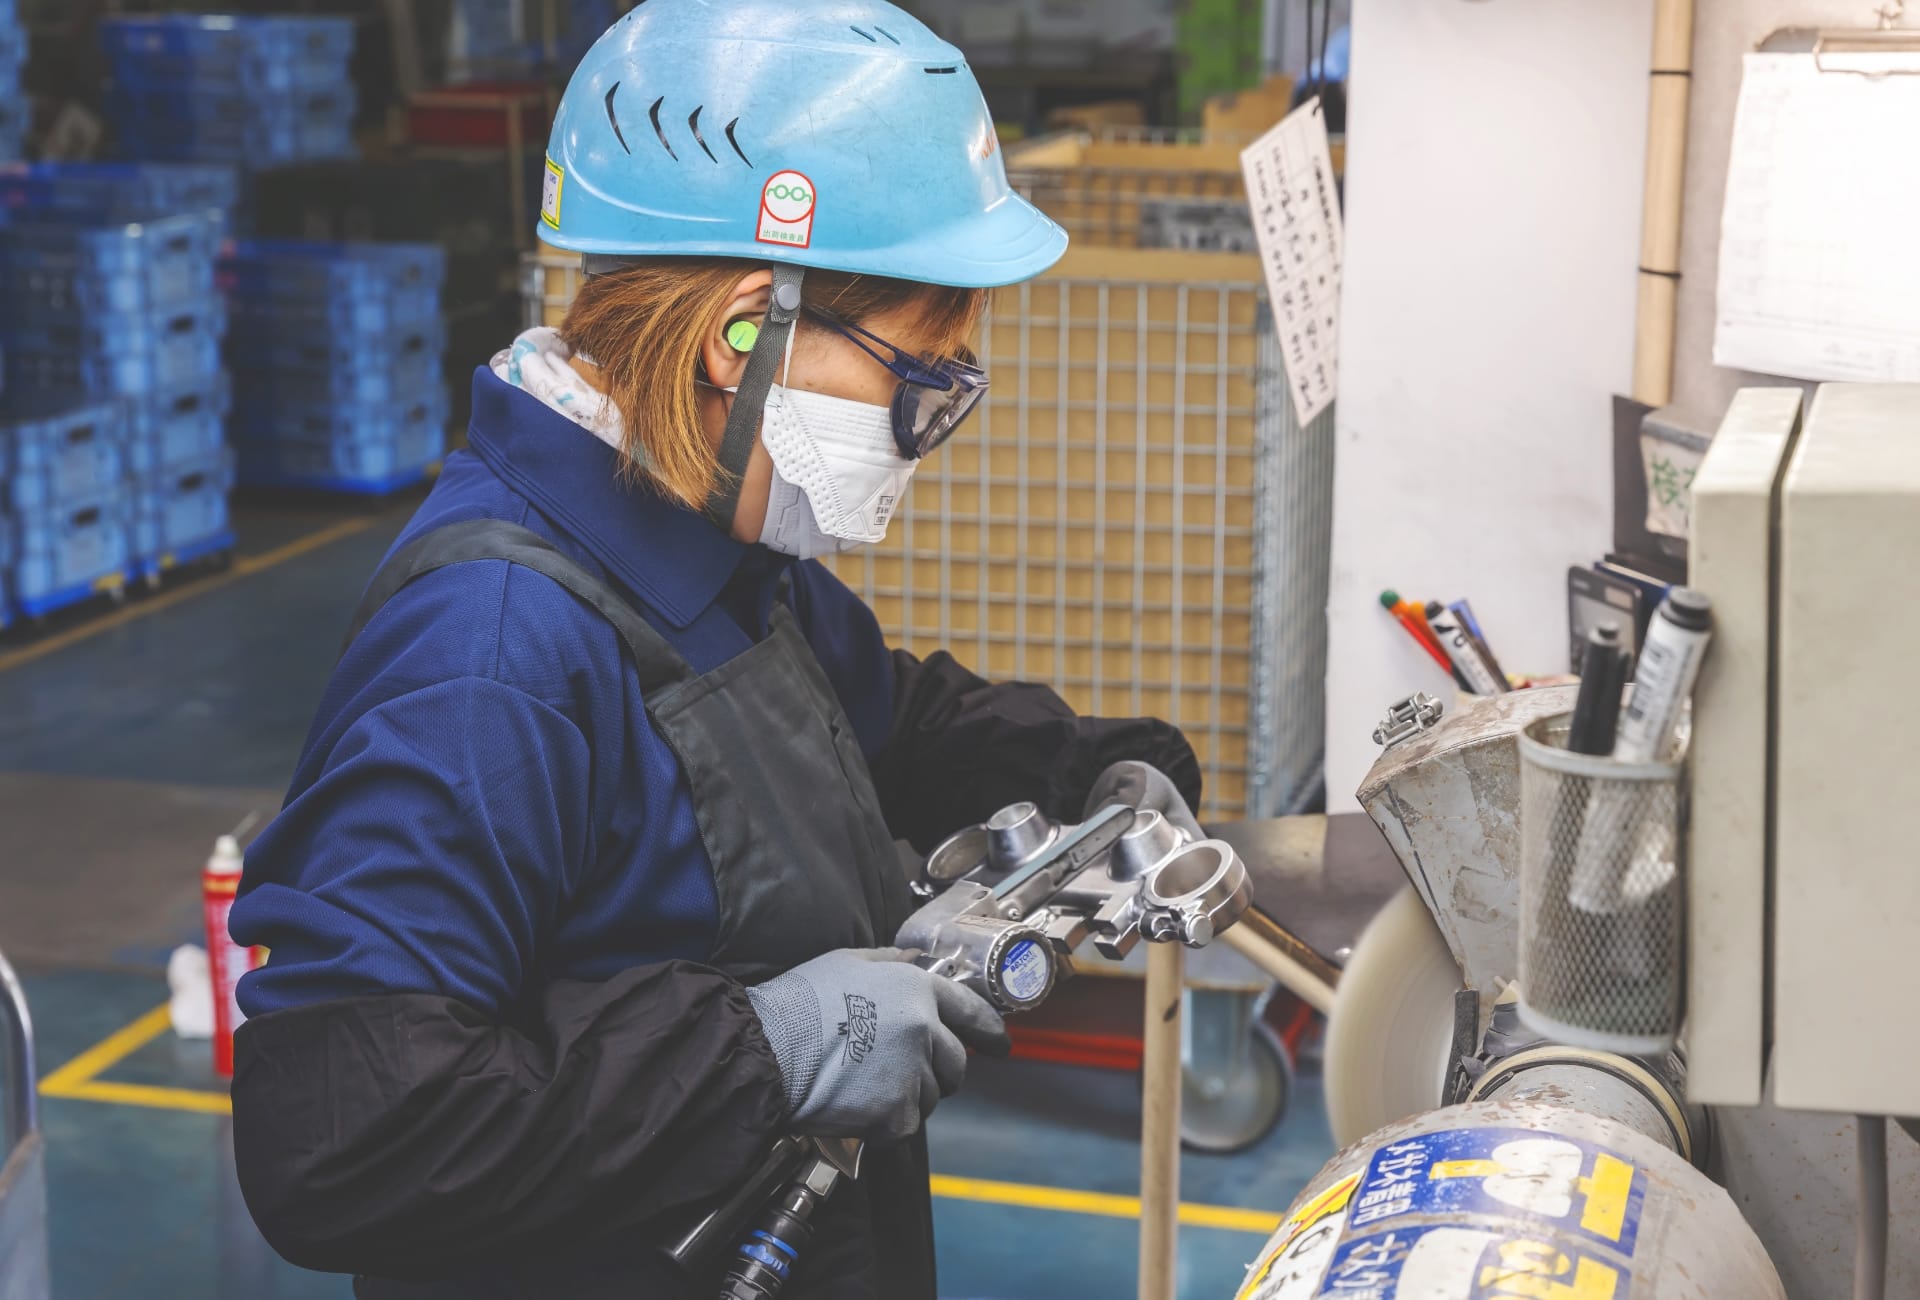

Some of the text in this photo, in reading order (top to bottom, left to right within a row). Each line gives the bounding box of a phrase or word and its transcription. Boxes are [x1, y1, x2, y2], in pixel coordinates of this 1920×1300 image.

[837, 1022, 847, 1036] M
[1353, 1142, 1426, 1225] メガネ着用
